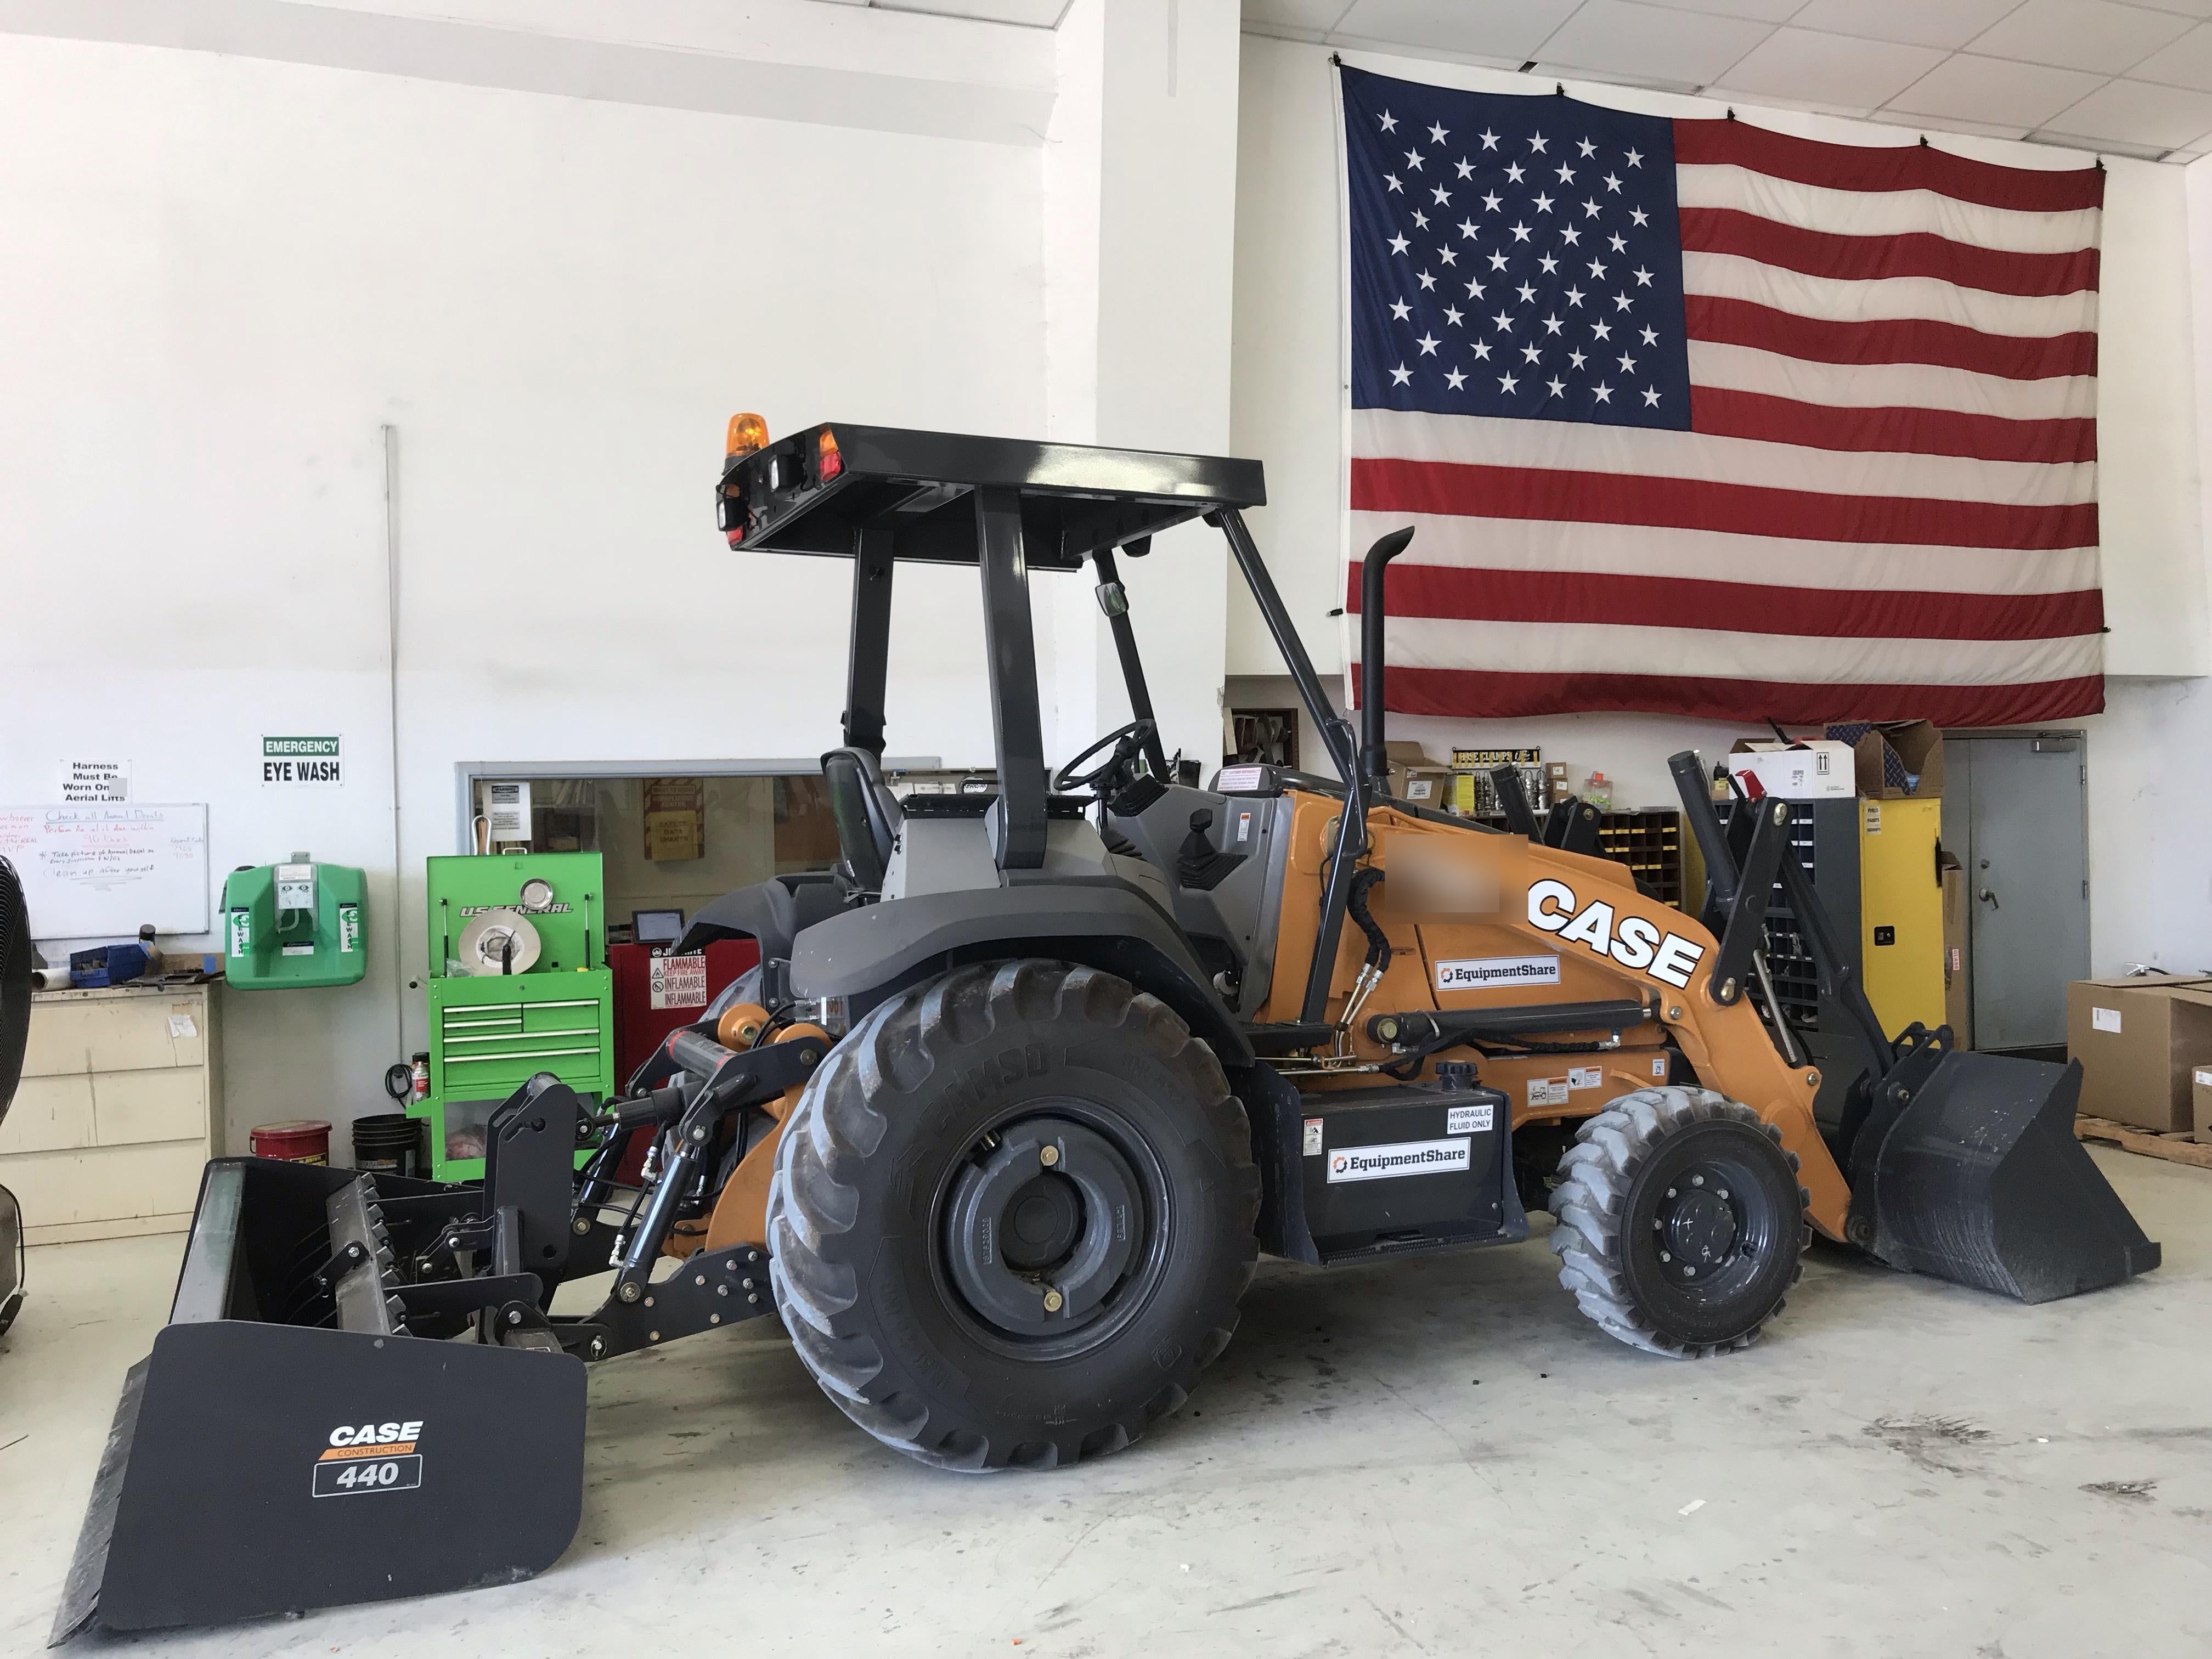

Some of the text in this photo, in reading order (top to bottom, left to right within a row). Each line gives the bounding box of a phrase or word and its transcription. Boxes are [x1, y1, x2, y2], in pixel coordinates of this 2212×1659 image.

[266, 741, 337, 753] EMERGENCY
[264, 761, 340, 781] EYE WASH
[1528, 878, 1706, 990] CASE
[663, 957, 705, 970] FLAMMABLE
[1455, 964, 1556, 981] EquipmentShare
[665, 976, 705, 990] INFLAMABLE
[665, 991, 706, 1007] INFLAMMABLE
[1450, 1109, 1492, 1119] HYDRAULIC
[1449, 1120, 1491, 1130] FLUID ONLY
[1350, 1149, 1465, 1171] EquipmentShare
[329, 1421, 424, 1446] CASE
[337, 1444, 411, 1457] CONSTRUCTION
[336, 1462, 399, 1488] 440
